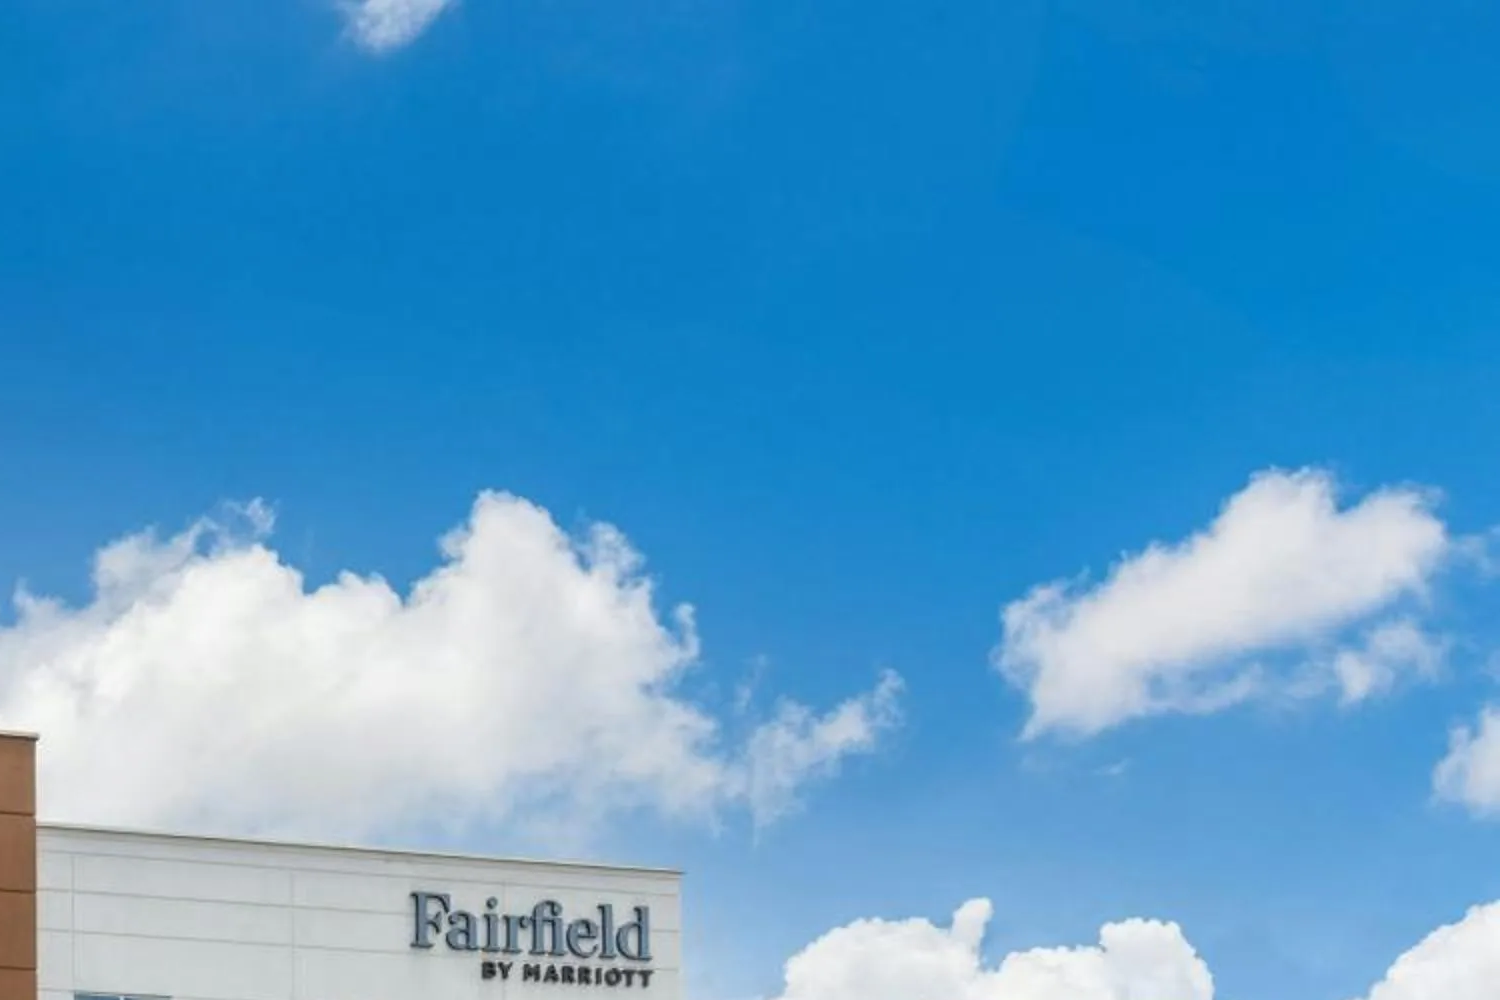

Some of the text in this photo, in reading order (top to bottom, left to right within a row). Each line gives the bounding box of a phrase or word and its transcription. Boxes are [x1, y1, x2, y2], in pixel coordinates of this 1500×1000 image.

[409, 891, 653, 961] Fairfield
[481, 961, 654, 988] BY MARRIOTT
